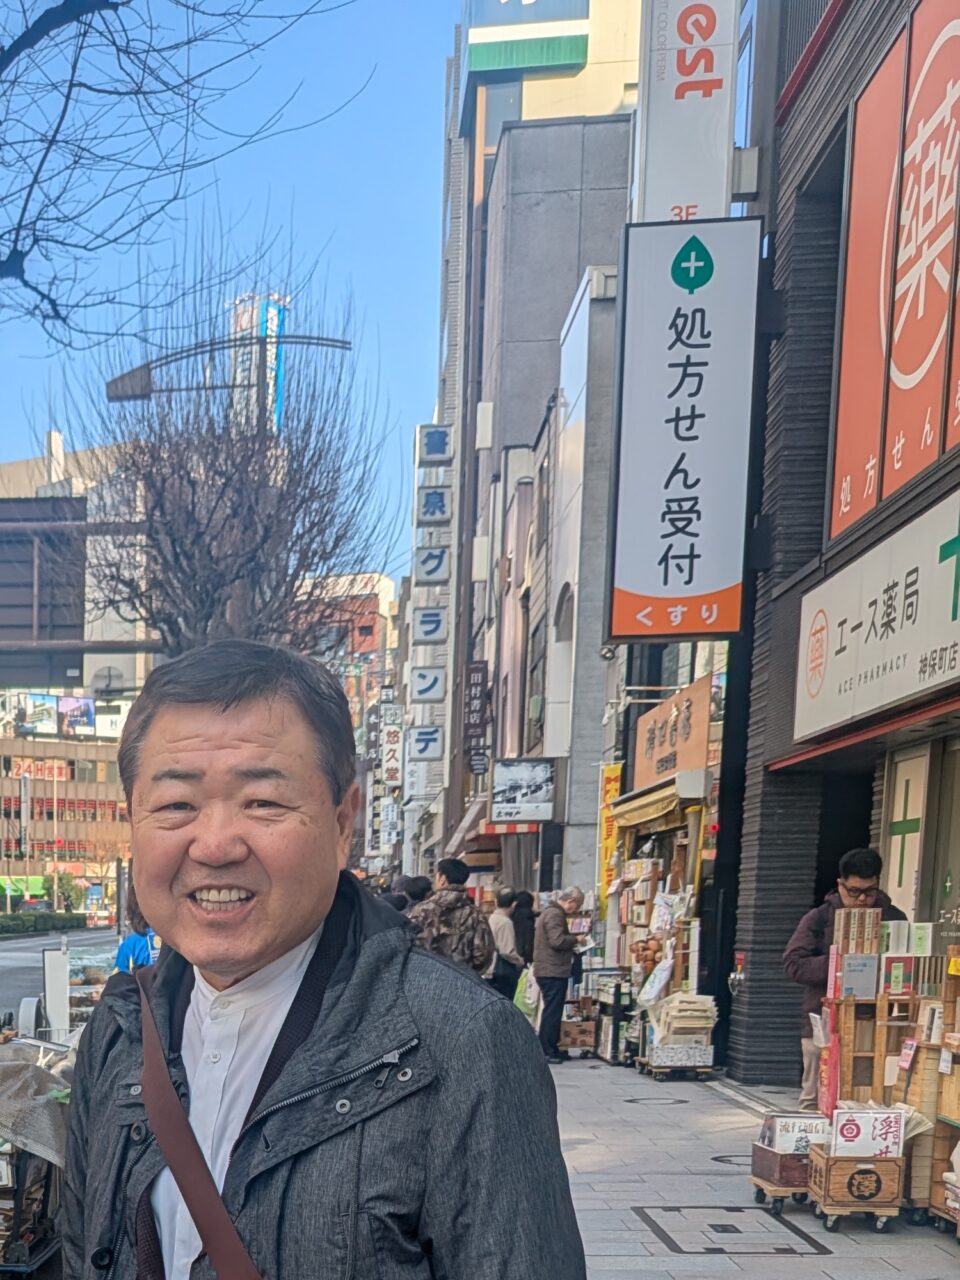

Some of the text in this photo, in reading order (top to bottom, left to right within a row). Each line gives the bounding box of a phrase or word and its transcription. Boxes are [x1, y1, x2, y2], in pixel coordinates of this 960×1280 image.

[657, 306, 711, 587] 処方せん受付
[415, 429, 448, 753] 書泉グランデ
[636, 603, 718, 626] くすり
[834, 566, 919, 656] エース薬局
[838, 653, 908, 696] ACE PHARMACY
[917, 641, 959, 684] 神保町店
[470, 672, 482, 724] 田村書店
[385, 729, 400, 782] 悠久堂
